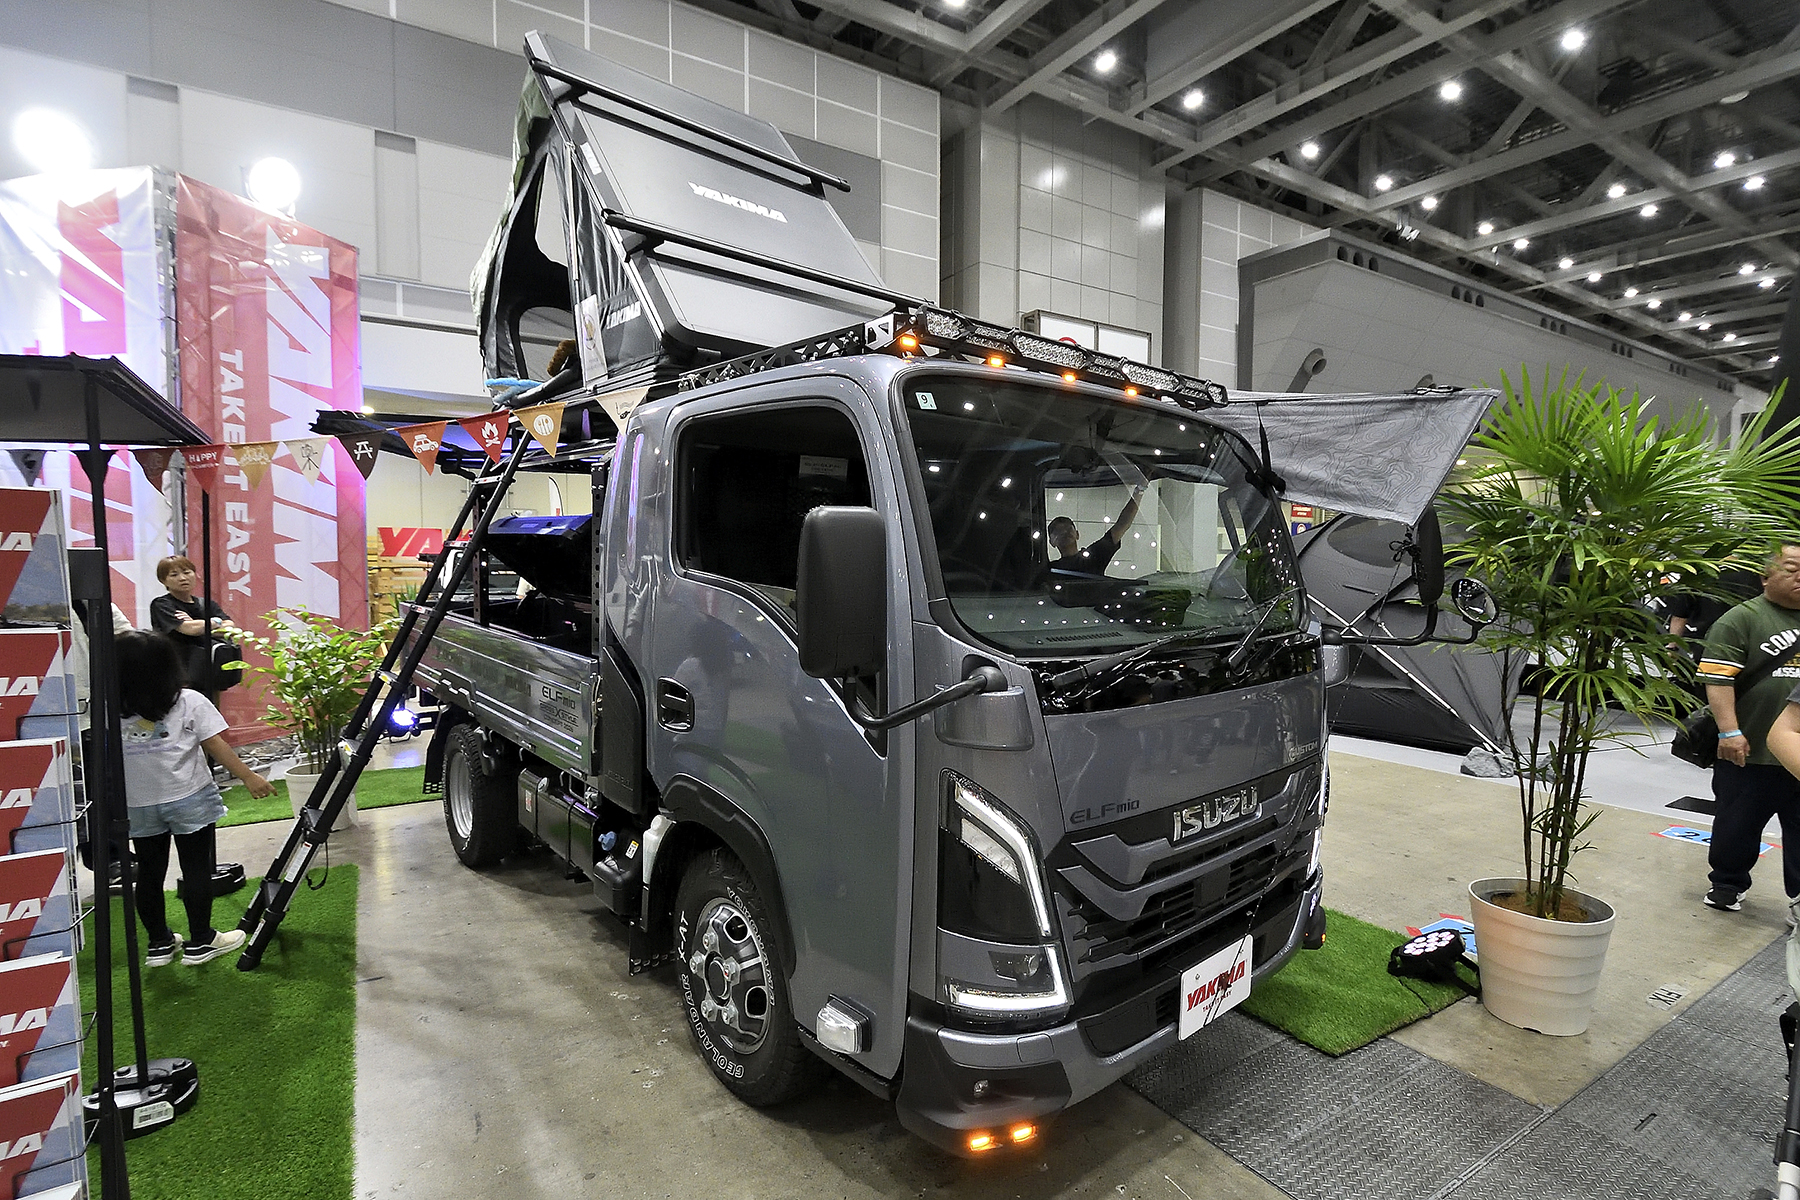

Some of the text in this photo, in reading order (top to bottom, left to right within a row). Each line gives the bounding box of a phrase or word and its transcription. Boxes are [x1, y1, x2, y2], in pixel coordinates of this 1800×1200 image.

[687, 181, 789, 223] YAKIMA
[921, 394, 928, 404] 9
[188, 451, 218, 464] HAPPY
[219, 349, 252, 597] TAKE IT EASY
[1069, 799, 1141, 825] ELFmio
[1173, 786, 1258, 842] ISUZU
[1187, 960, 1246, 1012] YAKMA
[680, 973, 746, 1079] GEOLANDAR
